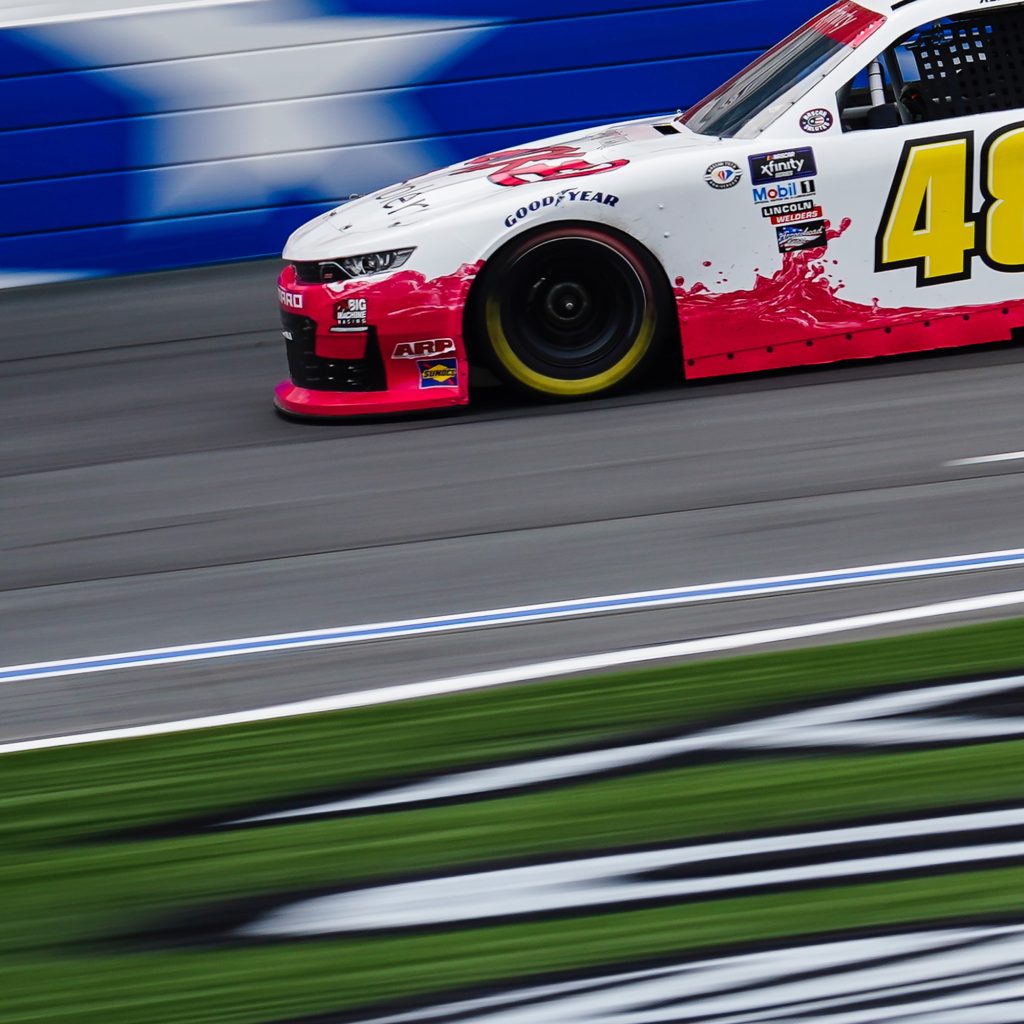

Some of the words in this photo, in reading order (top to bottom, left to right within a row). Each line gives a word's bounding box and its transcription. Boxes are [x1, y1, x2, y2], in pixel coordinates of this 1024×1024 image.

[760, 158, 804, 176] xfinity
[752, 182, 797, 202] Mobil
[504, 188, 620, 228] GOODYEAR
[763, 201, 812, 216] LINCOLN
[776, 210, 818, 224] WELDERS
[348, 298, 367, 311] BIG
[393, 339, 454, 358] ARP
